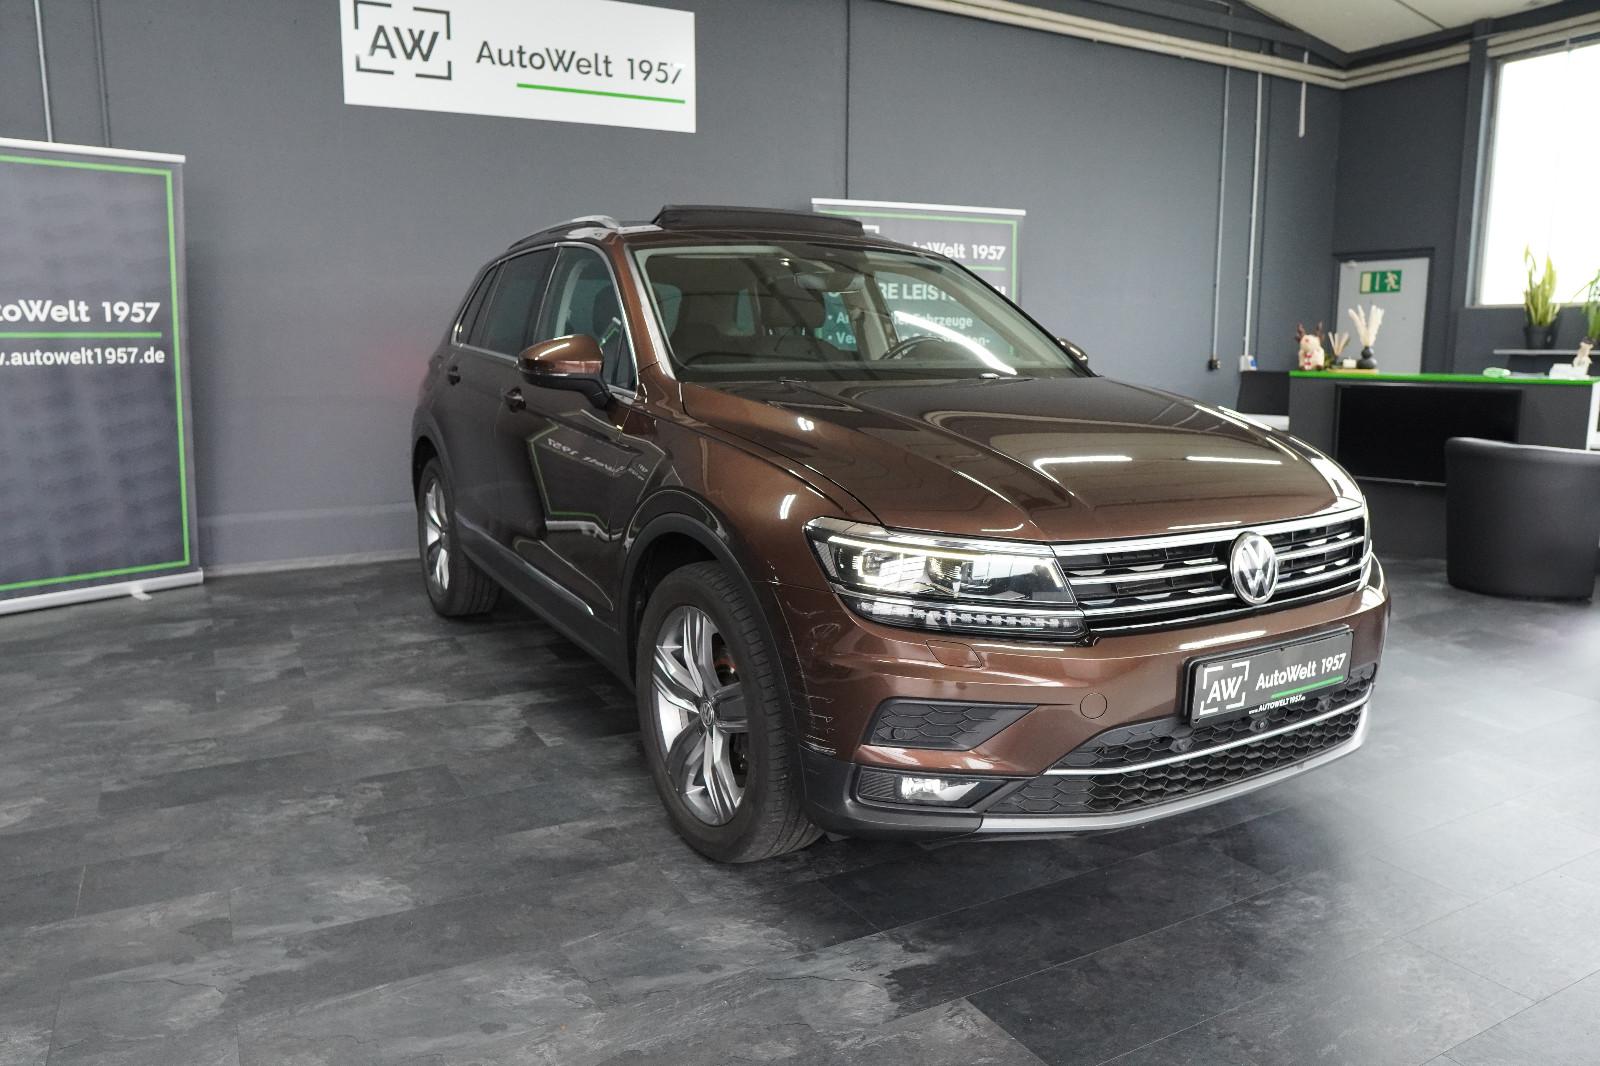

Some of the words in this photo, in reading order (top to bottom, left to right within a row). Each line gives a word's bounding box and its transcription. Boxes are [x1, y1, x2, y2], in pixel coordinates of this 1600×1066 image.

[369, 25, 440, 62] AW
[476, 41, 614, 79] AutoWelt
[627, 58, 685, 84] 1957
[971, 244, 1007, 261] 1957
[0, 299, 91, 323] oWelt
[102, 301, 161, 323] 1957
[1255, 662, 1317, 691] AutoWelt
[1321, 652, 1347, 675] 1957
[1207, 675, 1244, 705] AW
